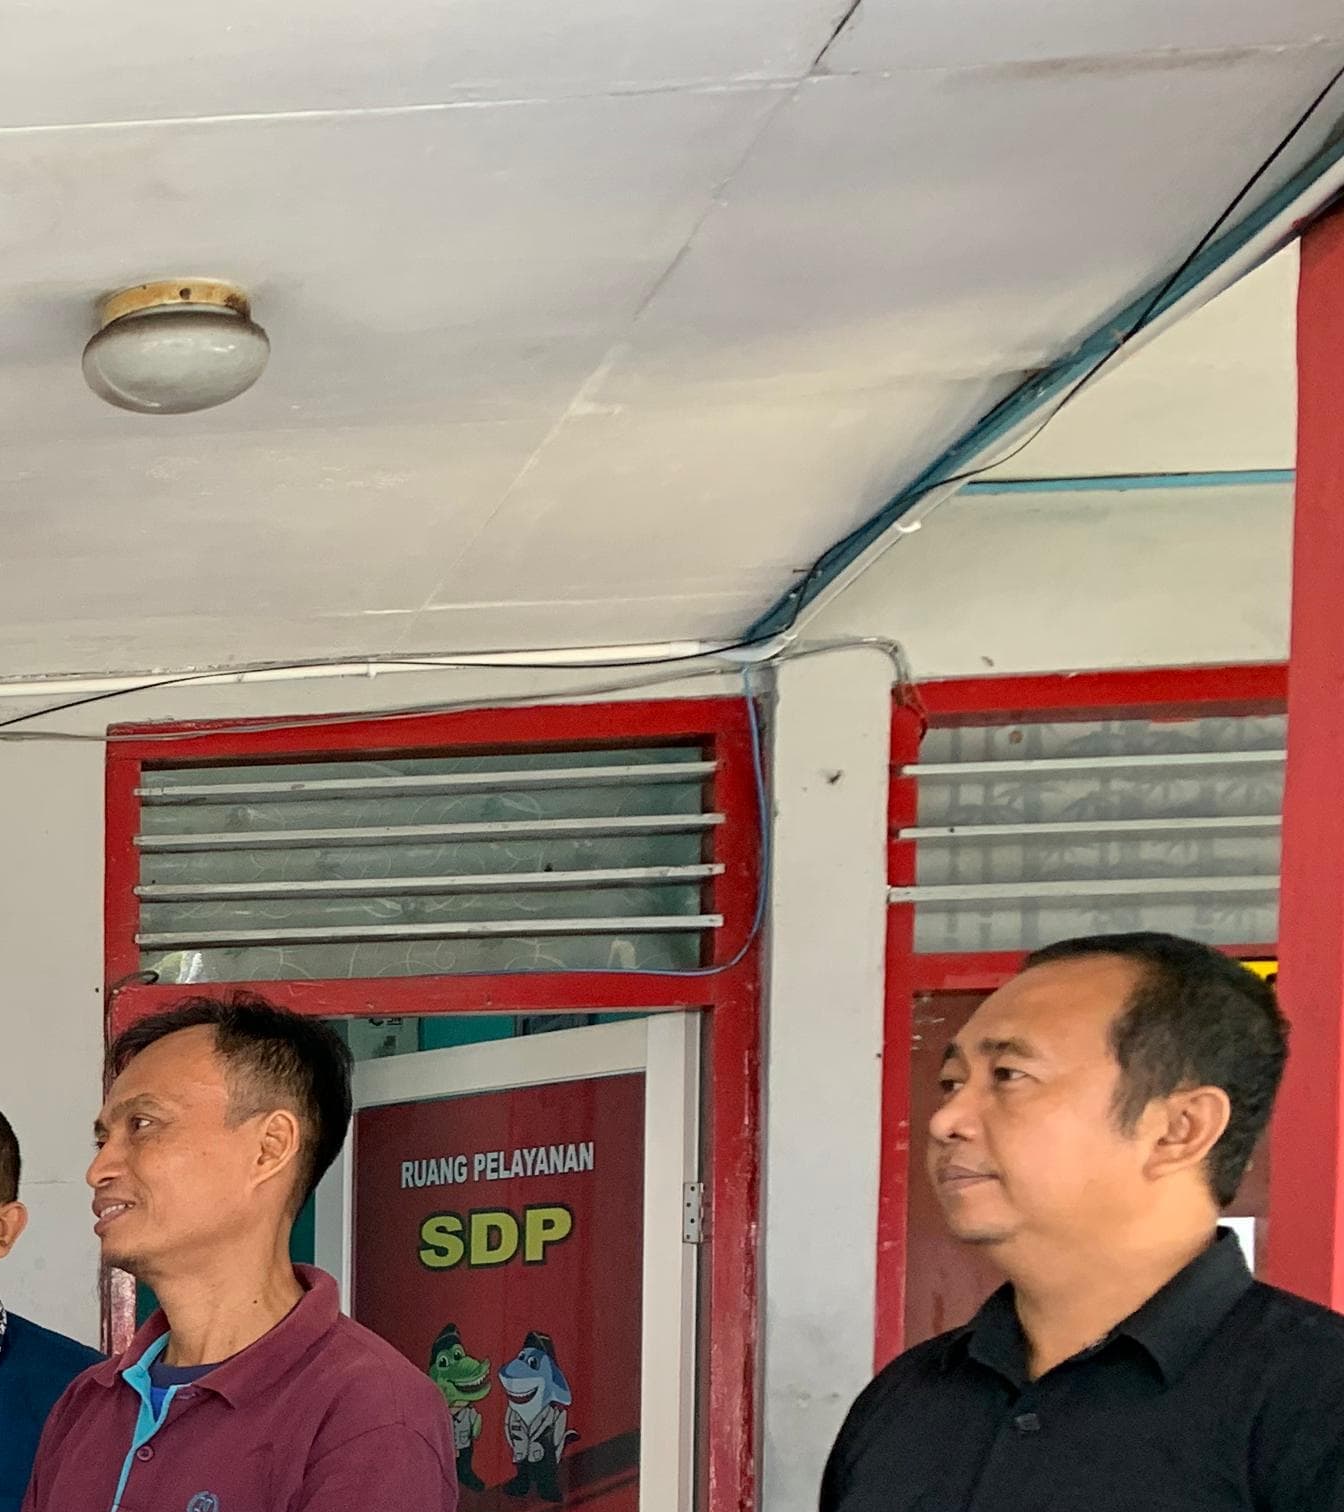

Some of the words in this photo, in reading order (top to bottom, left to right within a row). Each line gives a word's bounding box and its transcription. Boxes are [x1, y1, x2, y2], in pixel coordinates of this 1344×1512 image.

[401, 1155, 467, 1188] RUANG
[473, 1142, 594, 1182] PELAYANAN
[419, 1206, 572, 1268] SDP
